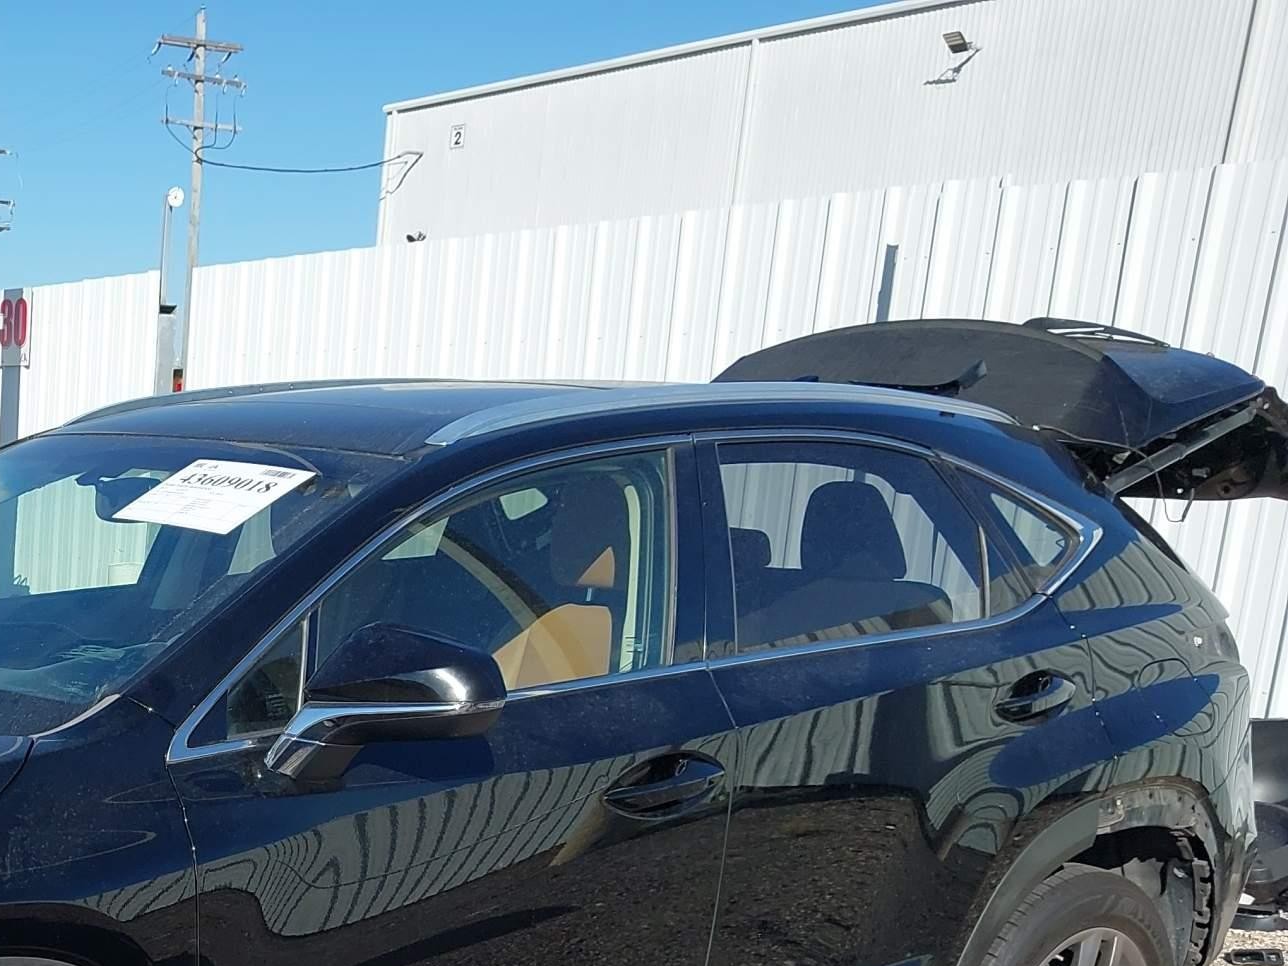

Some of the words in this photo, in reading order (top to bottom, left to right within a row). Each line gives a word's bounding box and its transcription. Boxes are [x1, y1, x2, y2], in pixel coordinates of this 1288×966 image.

[454, 131, 462, 145] 2
[0, 298, 28, 347] 30
[179, 473, 278, 494] 43609018
